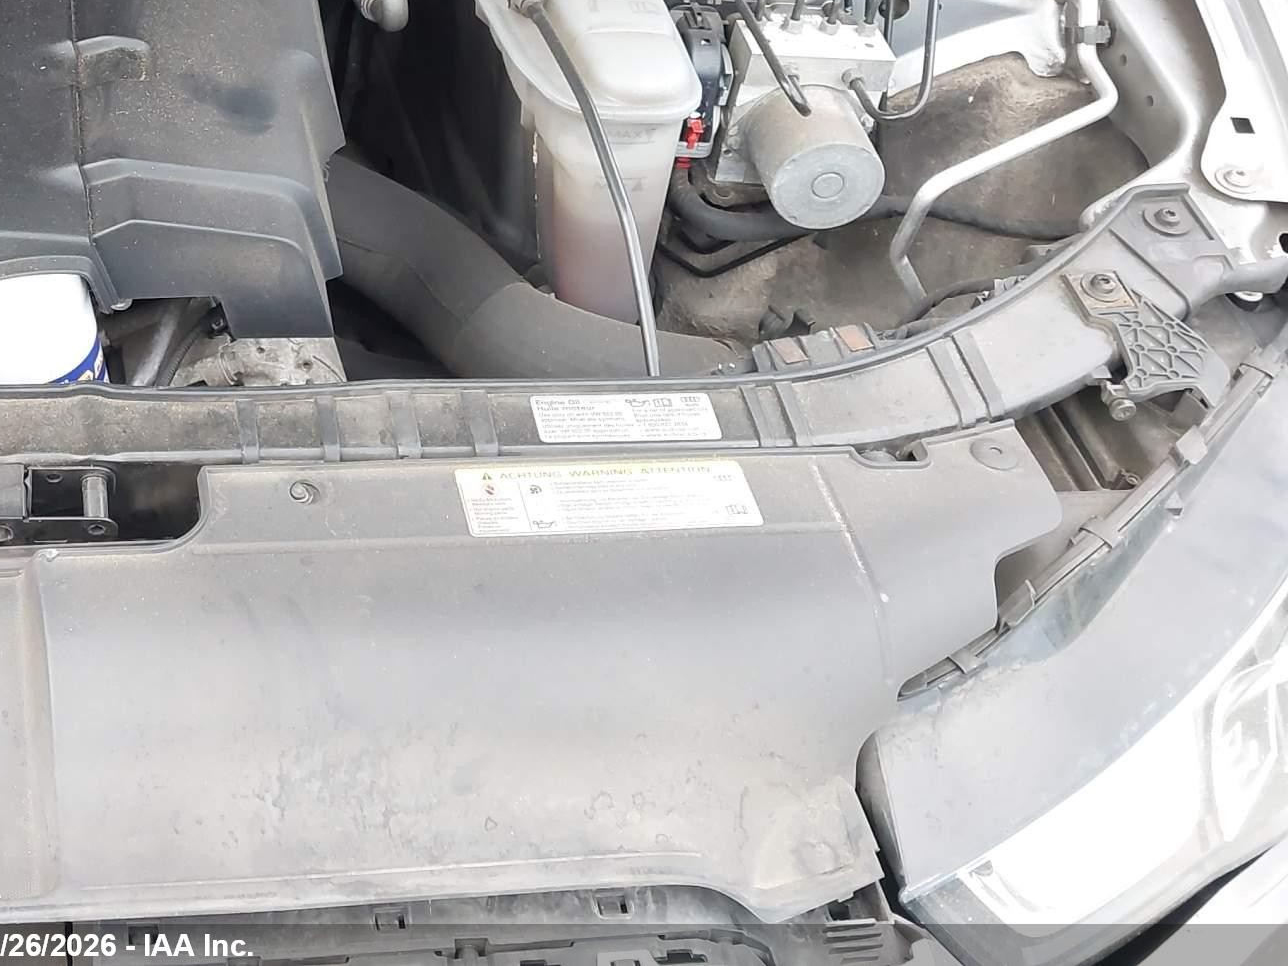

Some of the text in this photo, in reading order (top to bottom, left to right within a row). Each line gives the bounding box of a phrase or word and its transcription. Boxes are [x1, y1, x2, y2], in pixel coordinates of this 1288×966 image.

[535, 399, 565, 408] Engine
[500, 470, 563, 480] ACHTUNG
[569, 467, 632, 477] WARNING
